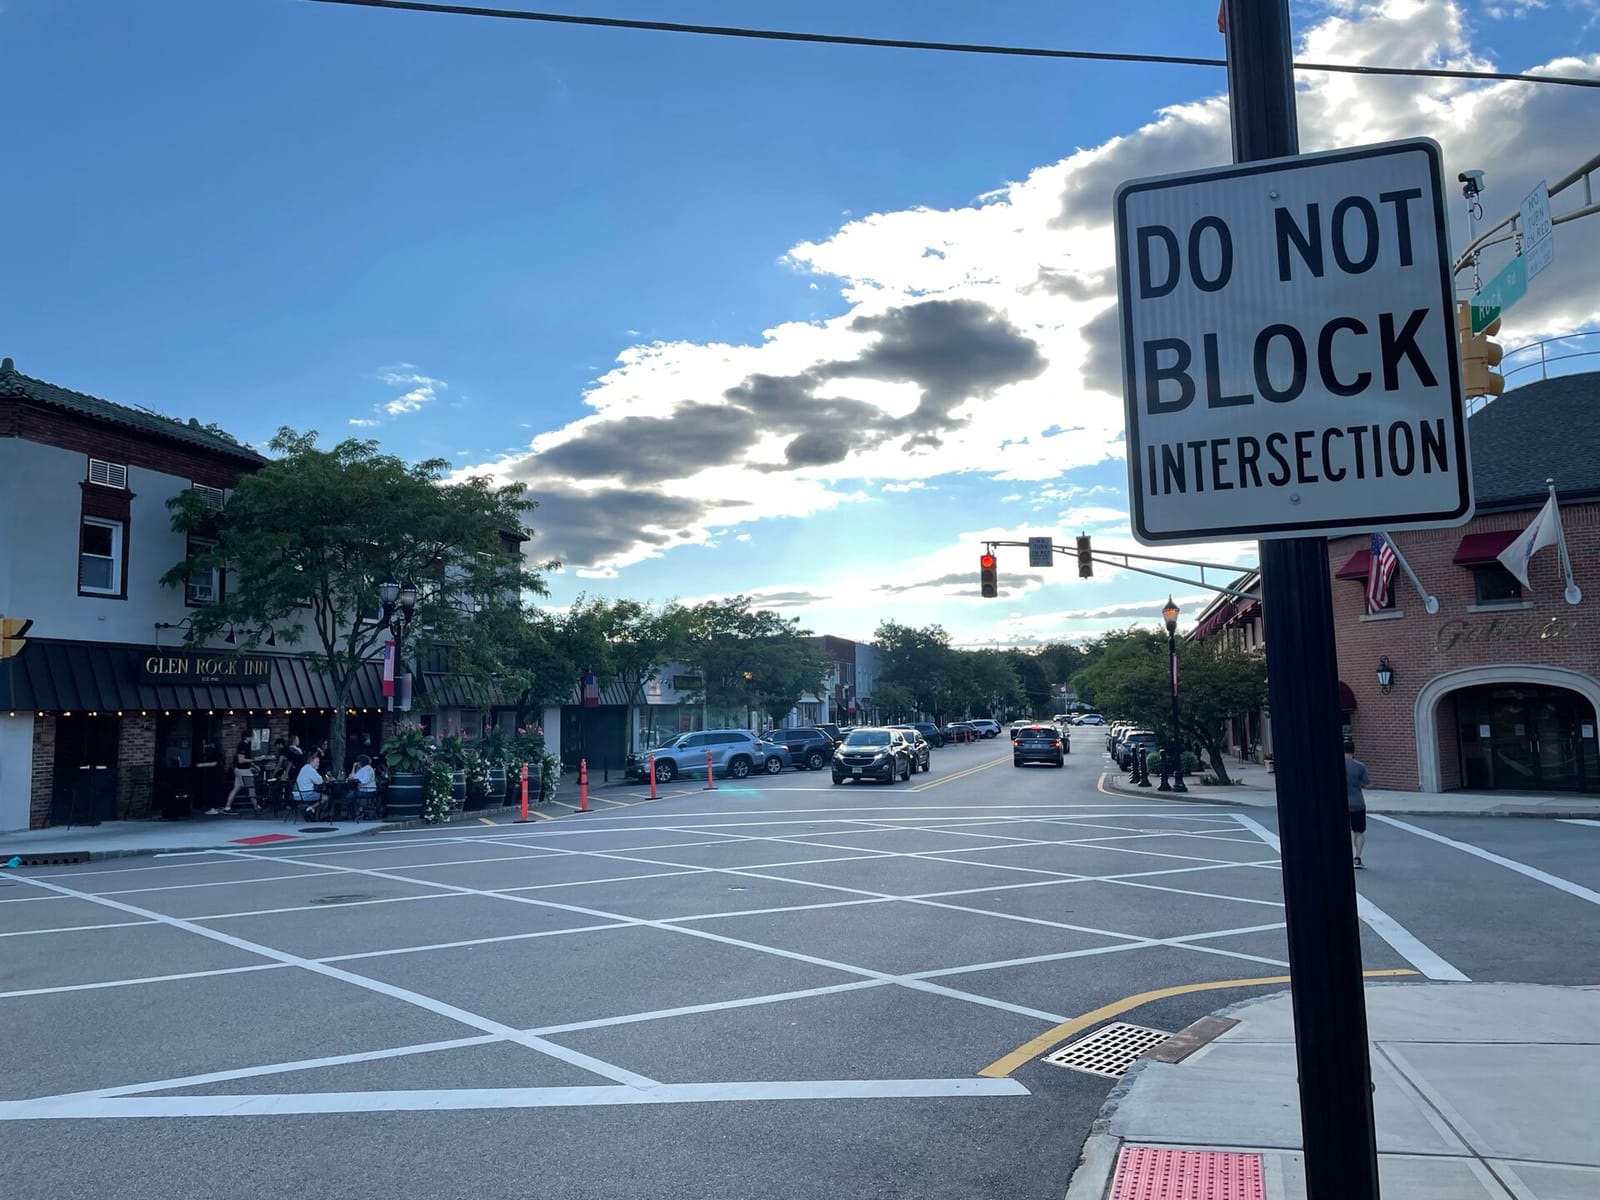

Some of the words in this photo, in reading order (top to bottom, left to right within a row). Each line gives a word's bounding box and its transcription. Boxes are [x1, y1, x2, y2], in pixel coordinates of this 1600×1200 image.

[1528, 192, 1539, 210] NO
[1527, 206, 1545, 229] TURN
[1136, 215, 1234, 299] DO
[1274, 187, 1423, 282] NOT
[1526, 231, 1536, 249] ON
[1536, 219, 1550, 240] RED
[1143, 307, 1439, 415] BLOCK
[1147, 418, 1450, 496] INTERSECTION
[145, 656, 189, 675] GLEN
[195, 658, 238, 675] ROCK
[244, 660, 268, 676] INN
